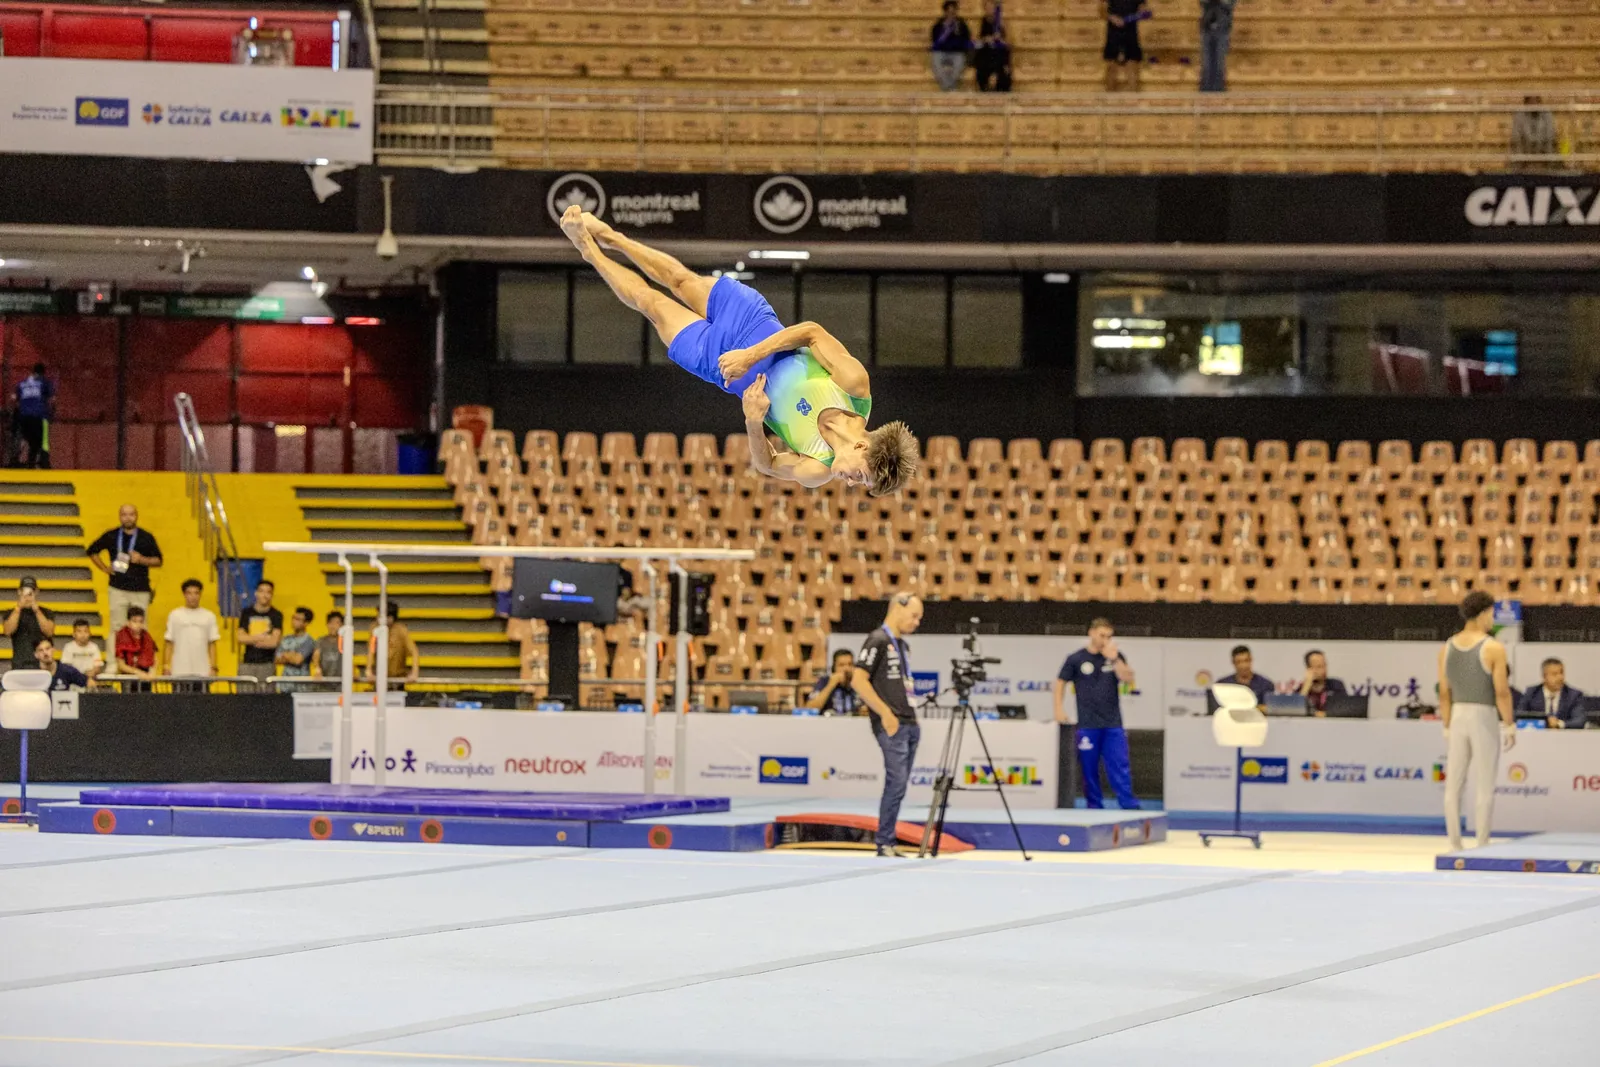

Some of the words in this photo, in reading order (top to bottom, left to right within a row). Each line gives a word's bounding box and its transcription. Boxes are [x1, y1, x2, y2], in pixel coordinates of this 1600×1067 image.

[101, 107, 126, 119] GDF
[219, 110, 272, 124] CAIXA
[280, 107, 361, 129] BRASIL
[168, 116, 212, 127] CAIXA
[611, 191, 701, 211] montreal
[818, 195, 908, 215] montreal
[612, 210, 674, 227] viagens
[820, 214, 881, 231] viagens
[1017, 680, 1053, 693] CAIX
[504, 756, 587, 775] neutrox
[1261, 765, 1286, 778] GDF
[781, 766, 806, 779] GDF
[964, 765, 1043, 785] BRASIL
[1325, 773, 1366, 782] CAIXA
[1374, 767, 1423, 780] CAIXA
[367, 825, 405, 837] SPIETH
